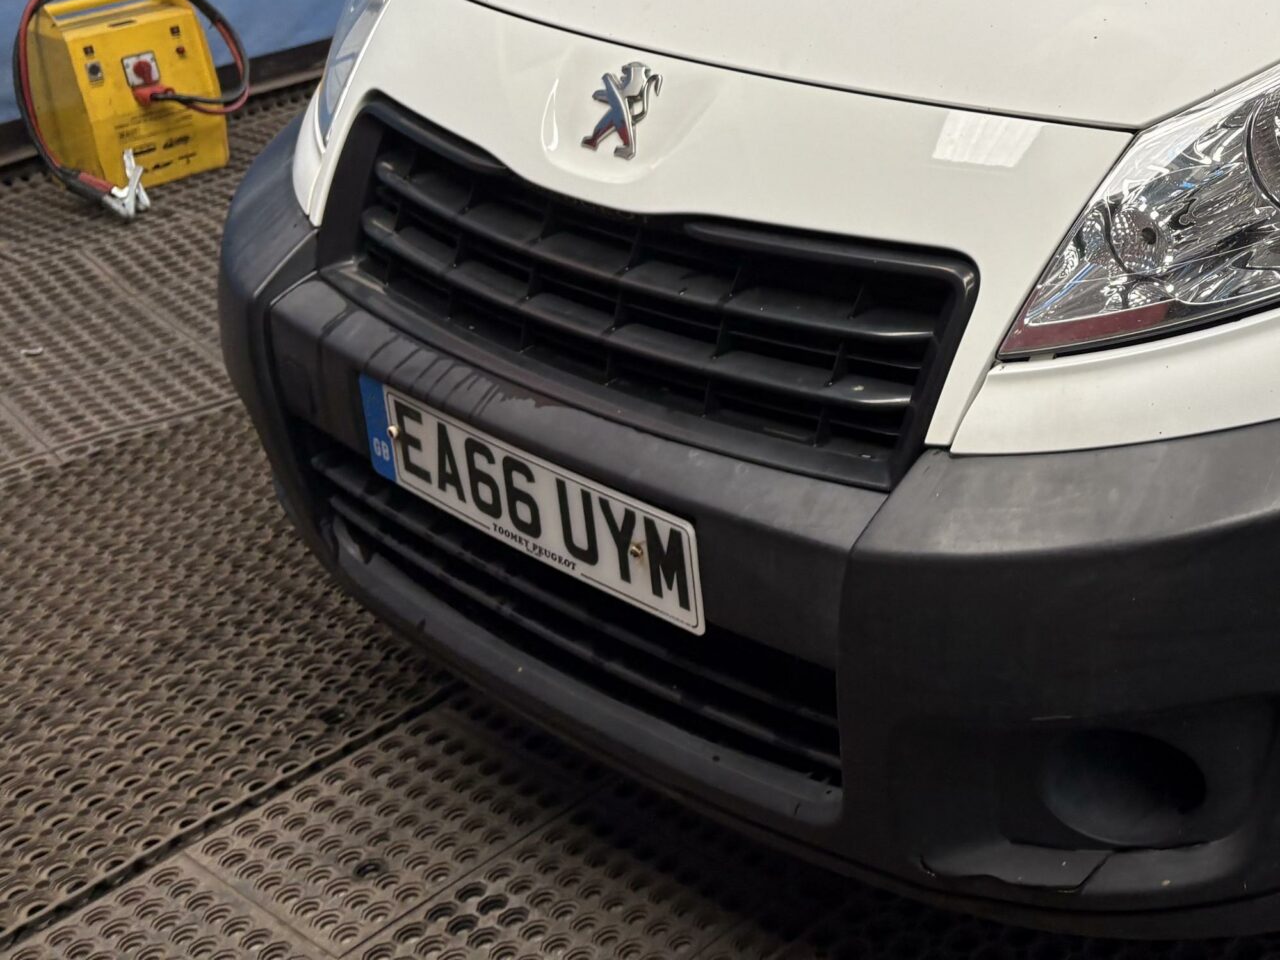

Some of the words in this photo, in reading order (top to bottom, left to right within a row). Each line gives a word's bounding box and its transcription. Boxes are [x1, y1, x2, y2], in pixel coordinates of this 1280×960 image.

[373, 436, 391, 462] GB
[394, 399, 542, 539] EA66
[555, 477, 690, 611] UYM
[532, 544, 577, 571] PEUGEOT
